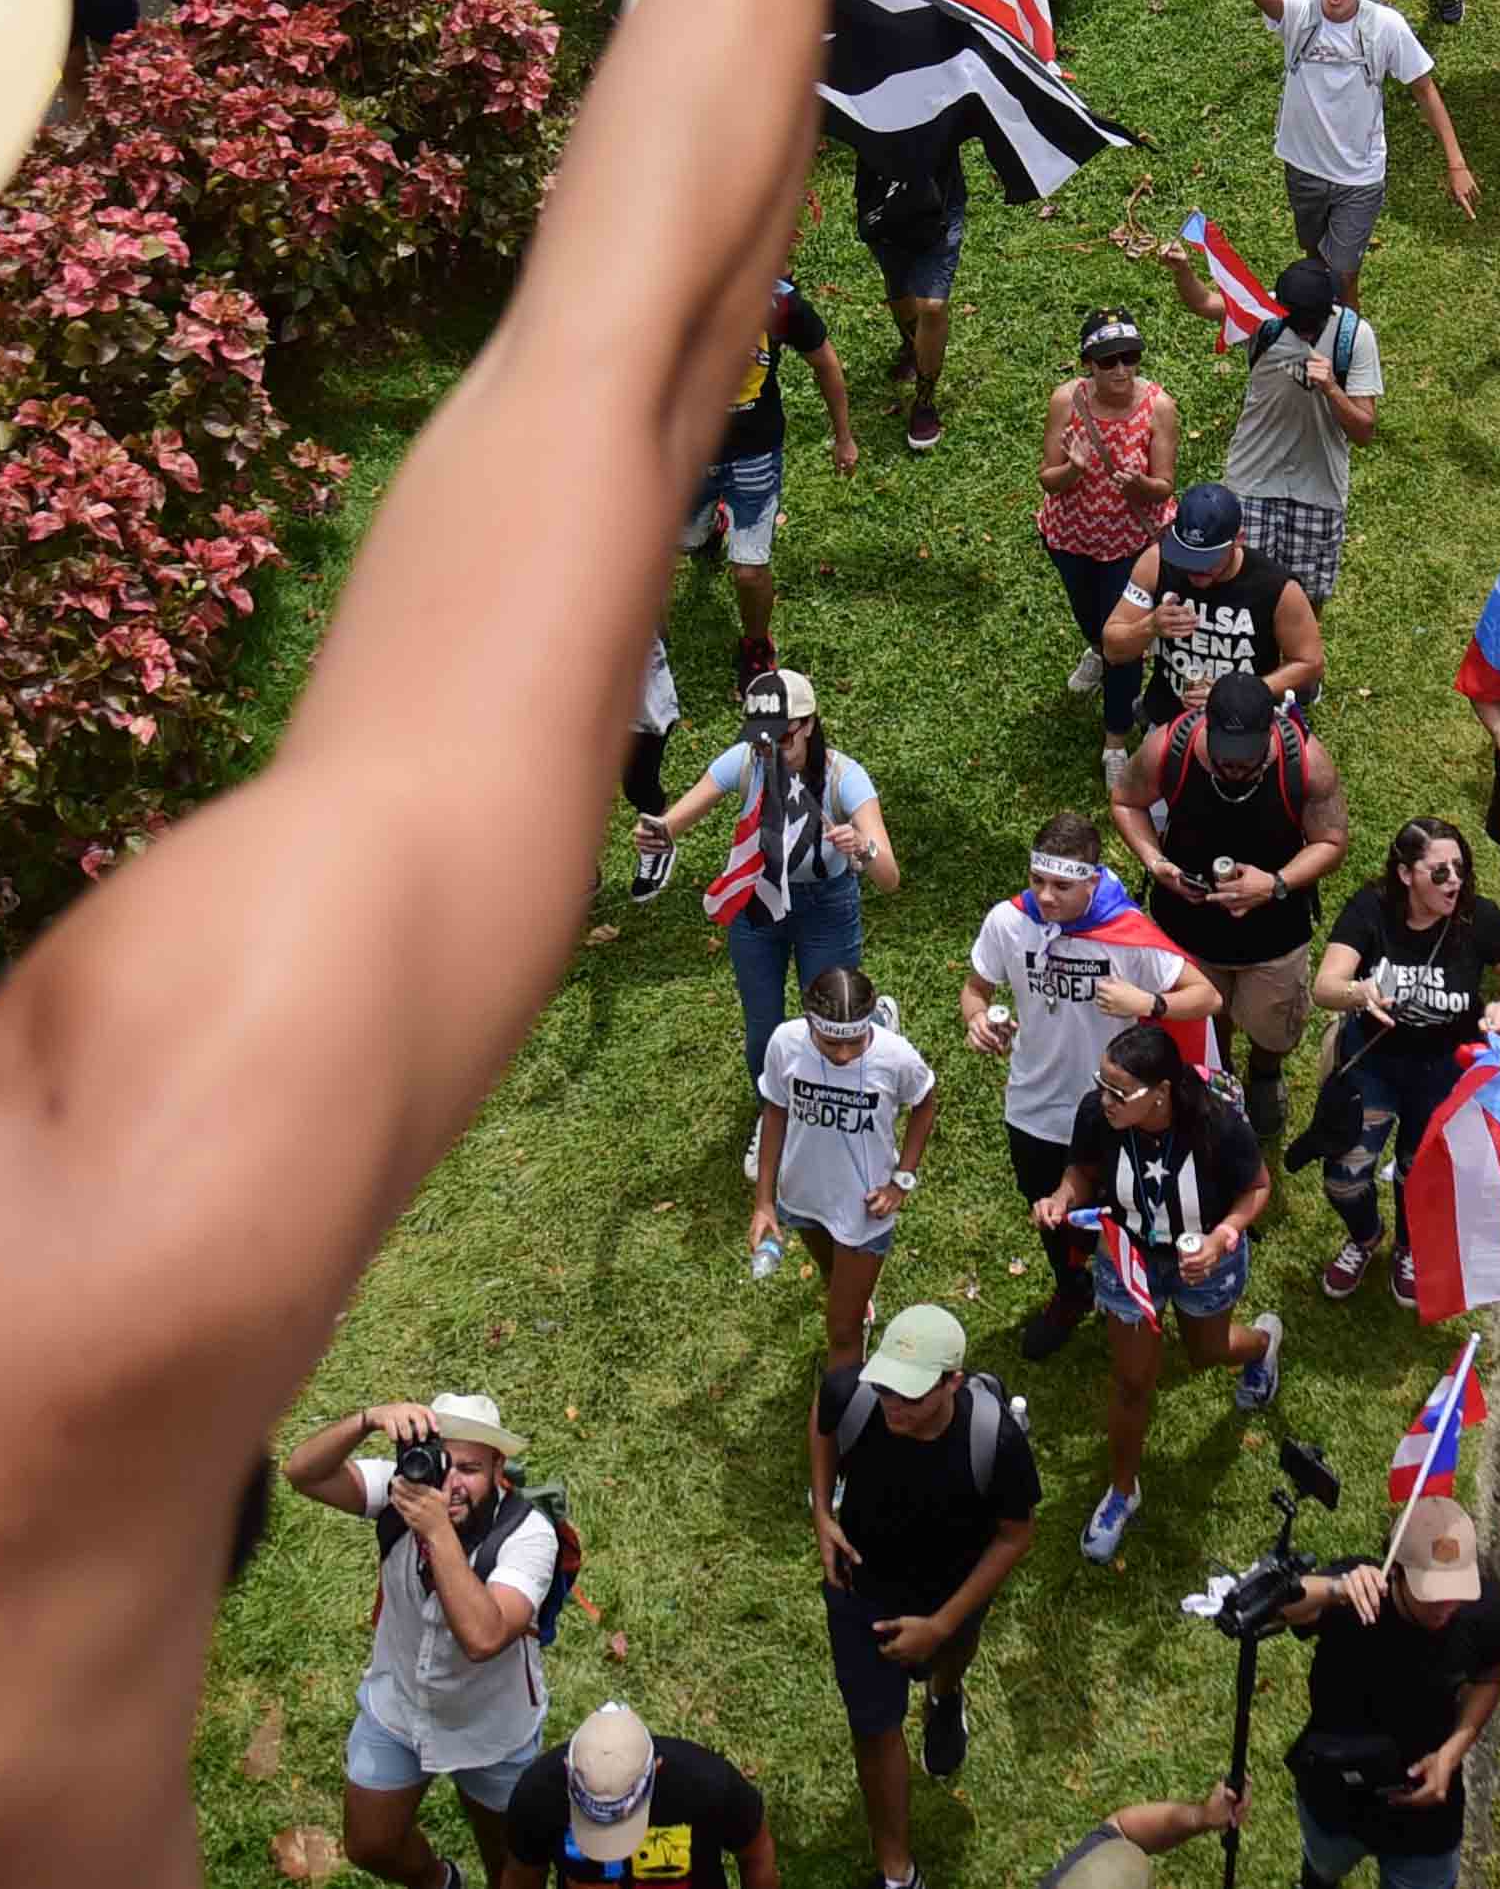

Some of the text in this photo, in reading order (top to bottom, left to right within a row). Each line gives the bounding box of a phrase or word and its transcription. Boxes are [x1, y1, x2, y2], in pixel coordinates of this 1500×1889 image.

[799, 1083, 812, 1098] La
[813, 1087, 870, 1110] generación
[793, 1109, 819, 1127] NO
[820, 1104, 875, 1134] DEJA
